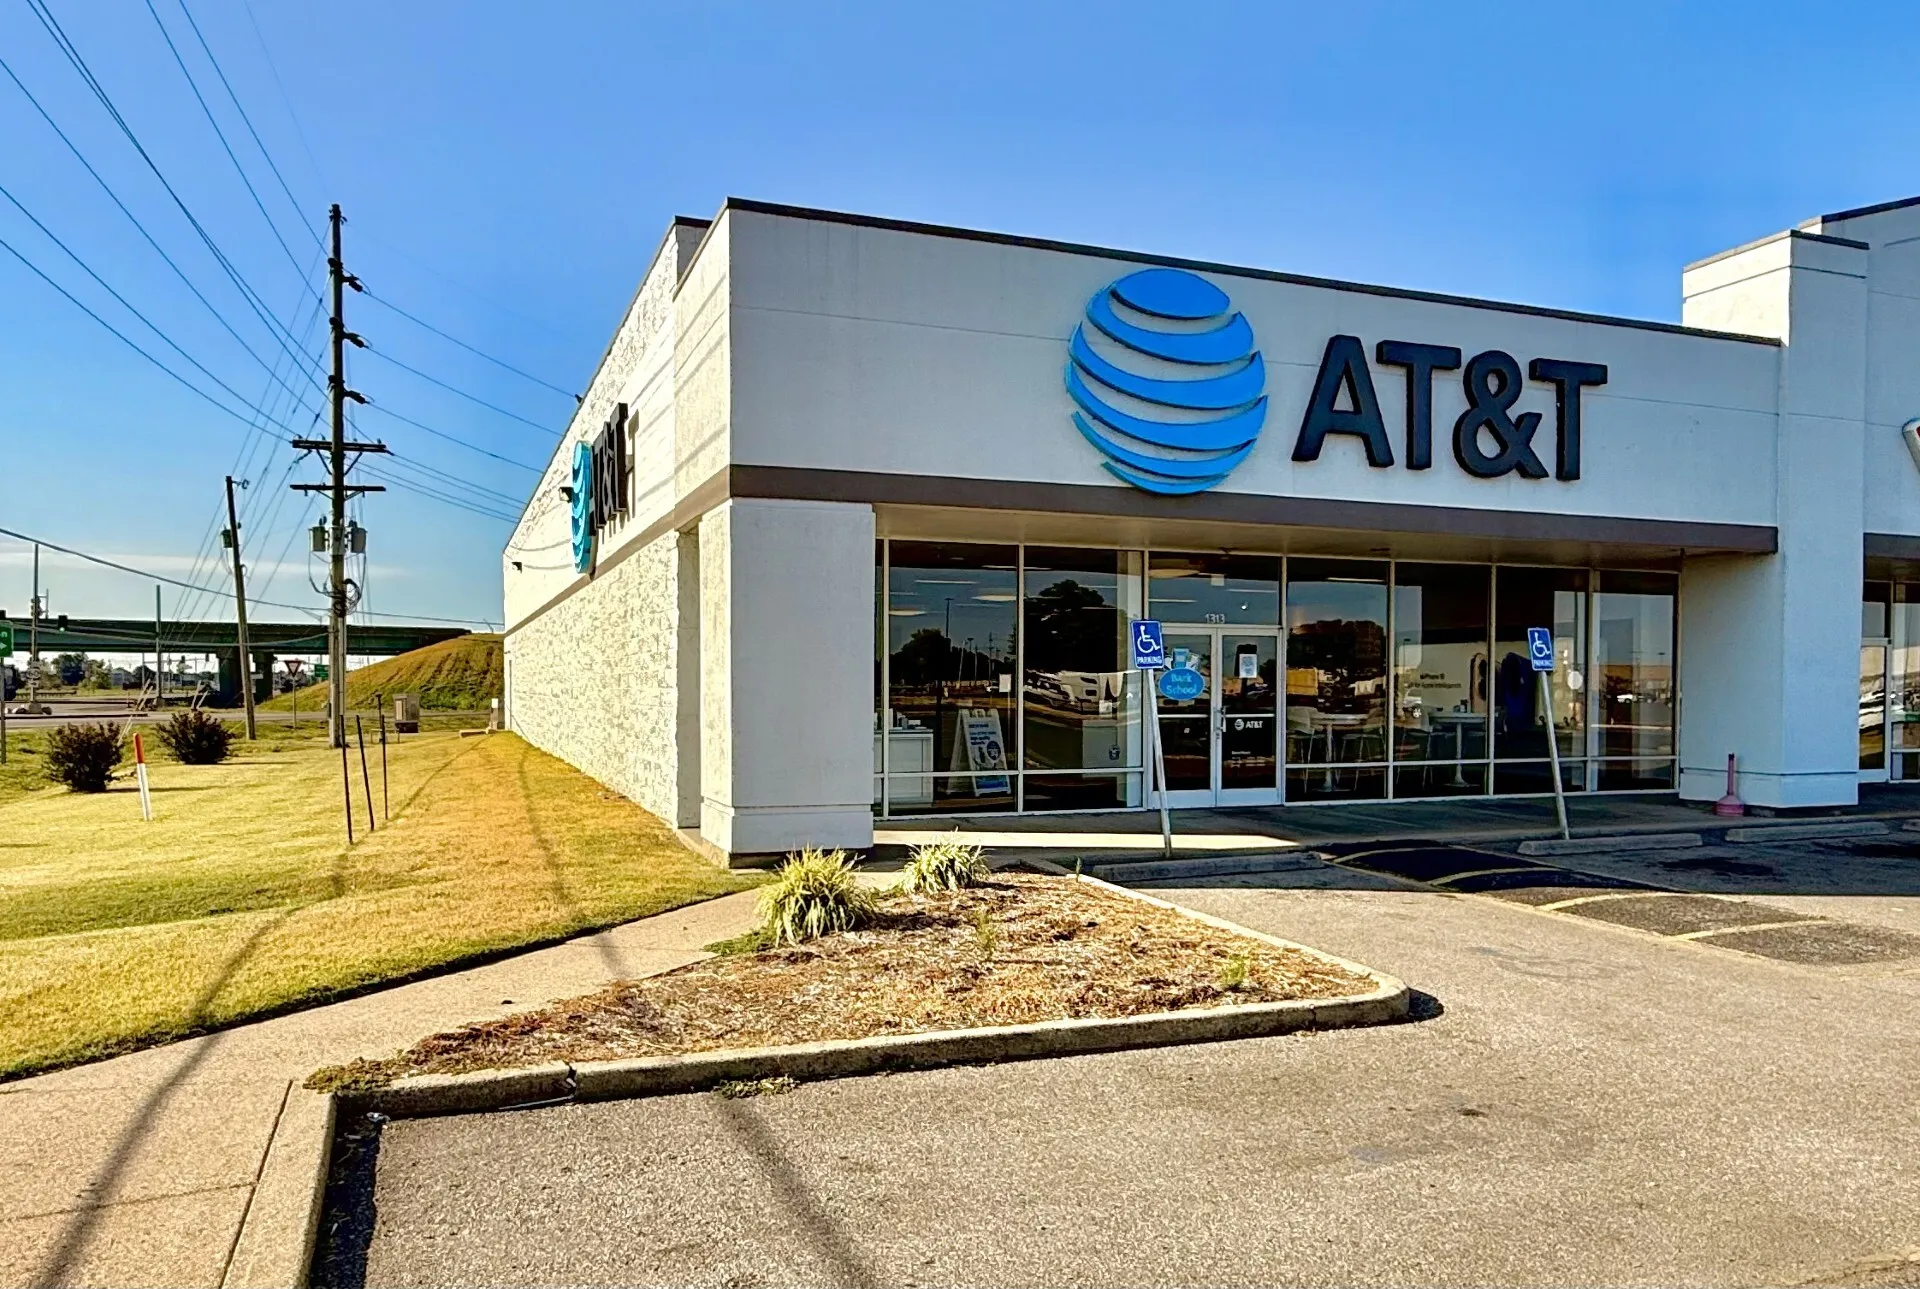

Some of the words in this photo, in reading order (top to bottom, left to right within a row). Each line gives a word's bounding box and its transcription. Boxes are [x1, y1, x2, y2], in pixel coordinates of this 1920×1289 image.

[1291, 334, 1608, 481] AT&T
[589, 402, 629, 537] AT&T
[1205, 613, 1225, 623] 1313
[1137, 655, 1163, 664] PARKING
[1166, 684, 1197, 694] School
[1245, 720, 1264, 728] AT&T
